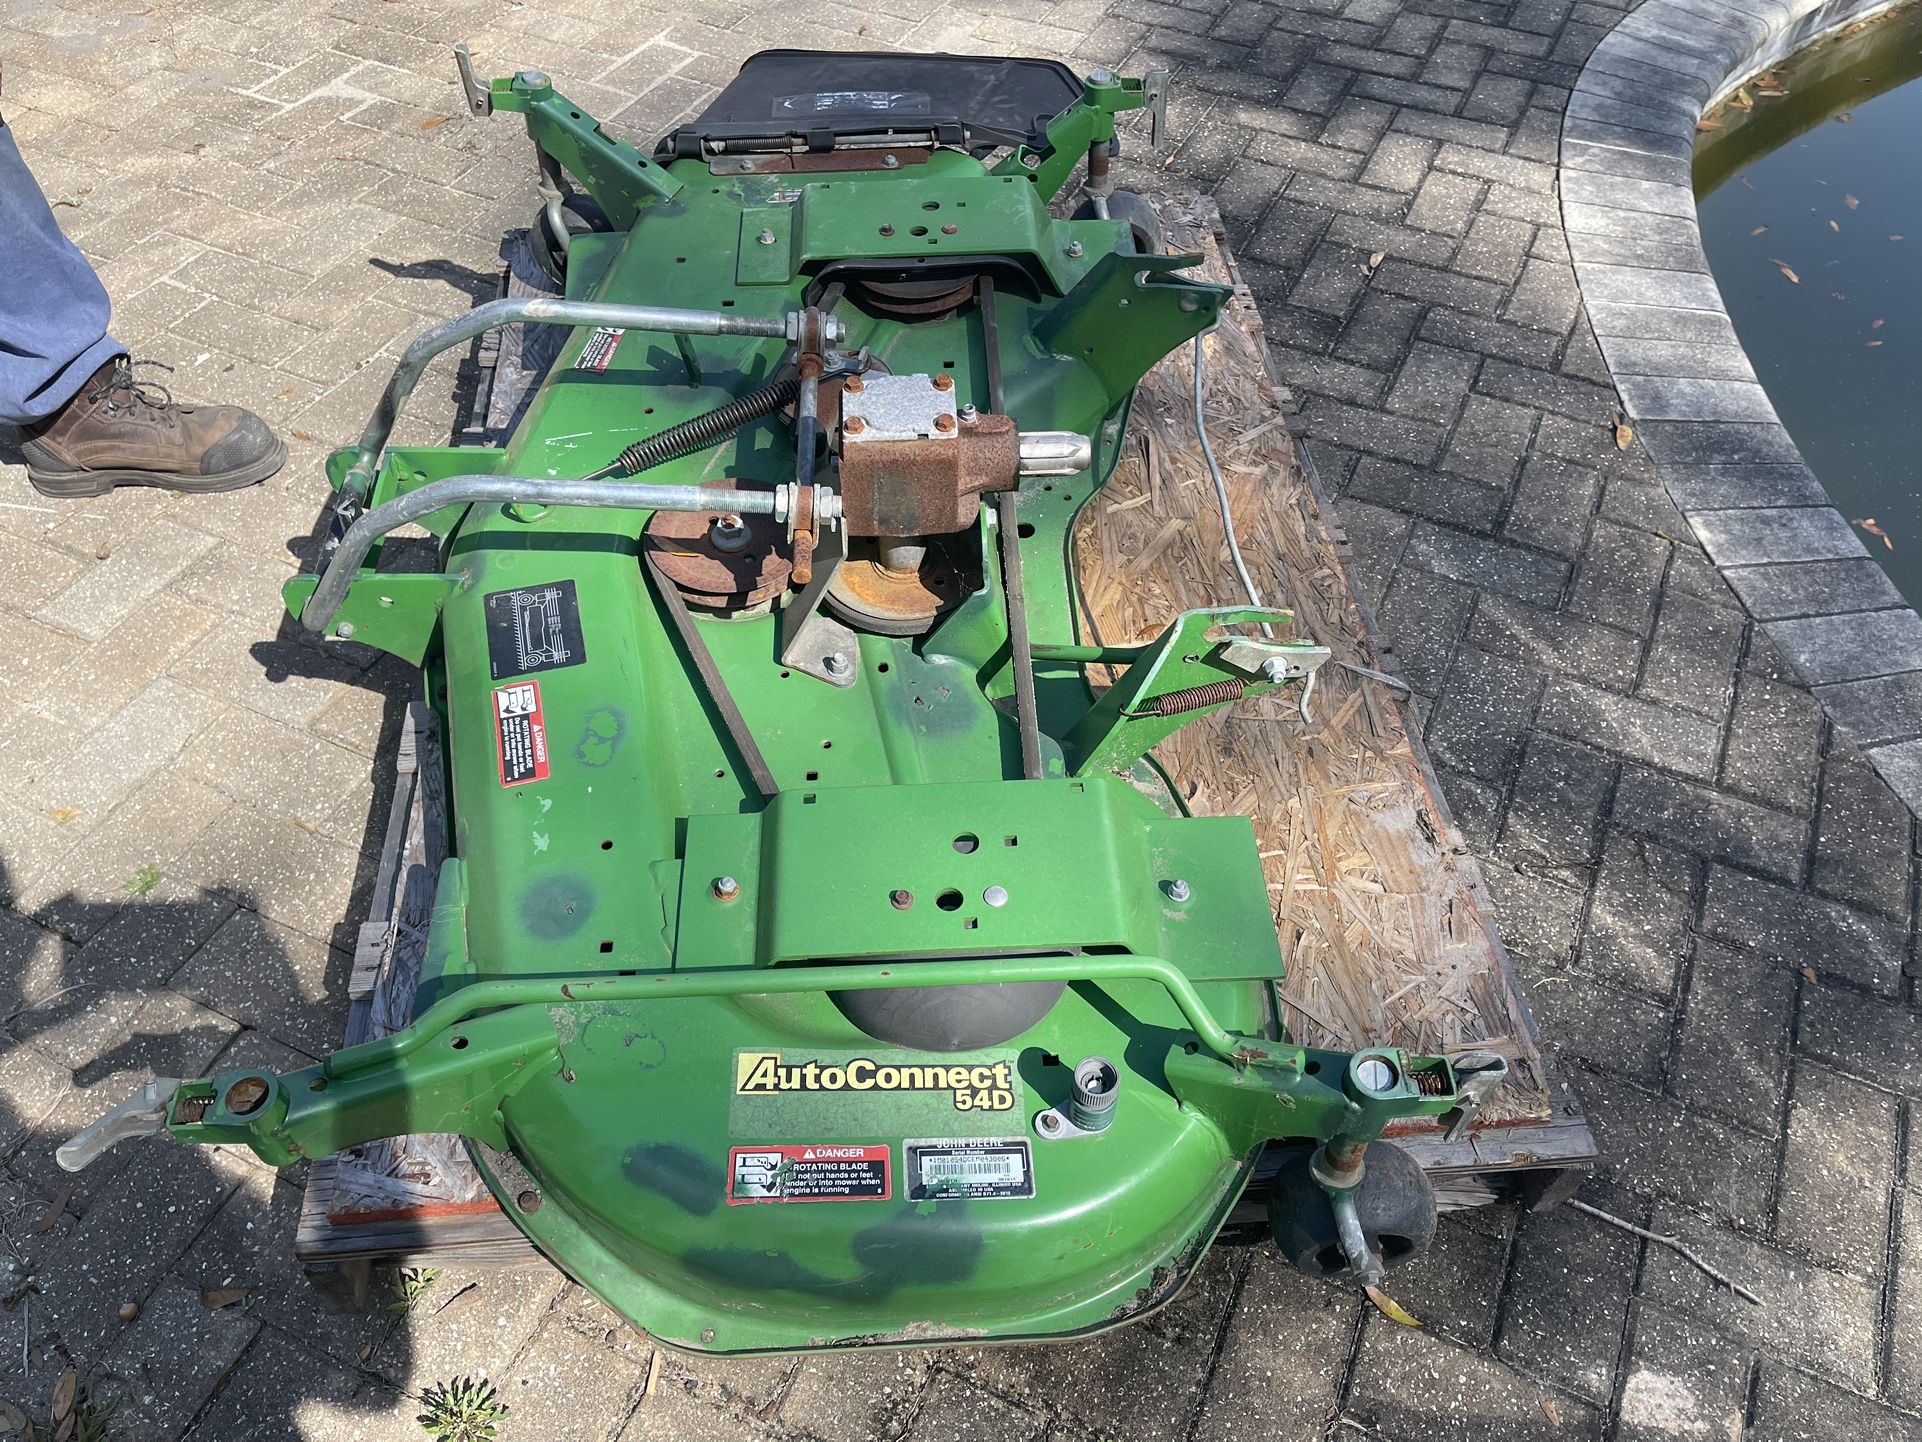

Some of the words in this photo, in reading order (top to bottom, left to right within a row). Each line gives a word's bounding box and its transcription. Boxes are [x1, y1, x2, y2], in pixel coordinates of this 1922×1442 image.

[522, 720, 531, 748] ROTATING
[534, 732, 546, 763] DANGER
[524, 748, 534, 769] BLADE
[742, 1058, 1011, 1091] AutoConnect
[955, 1090, 1014, 1110] 54D
[936, 1138, 965, 1148] JOHN
[969, 1137, 1004, 1148] DEERE
[816, 1148, 864, 1158] DANGER
[793, 1162, 838, 1171] ROTATING
[840, 1162, 869, 1170] BLADE
[820, 1186, 850, 1194] running
